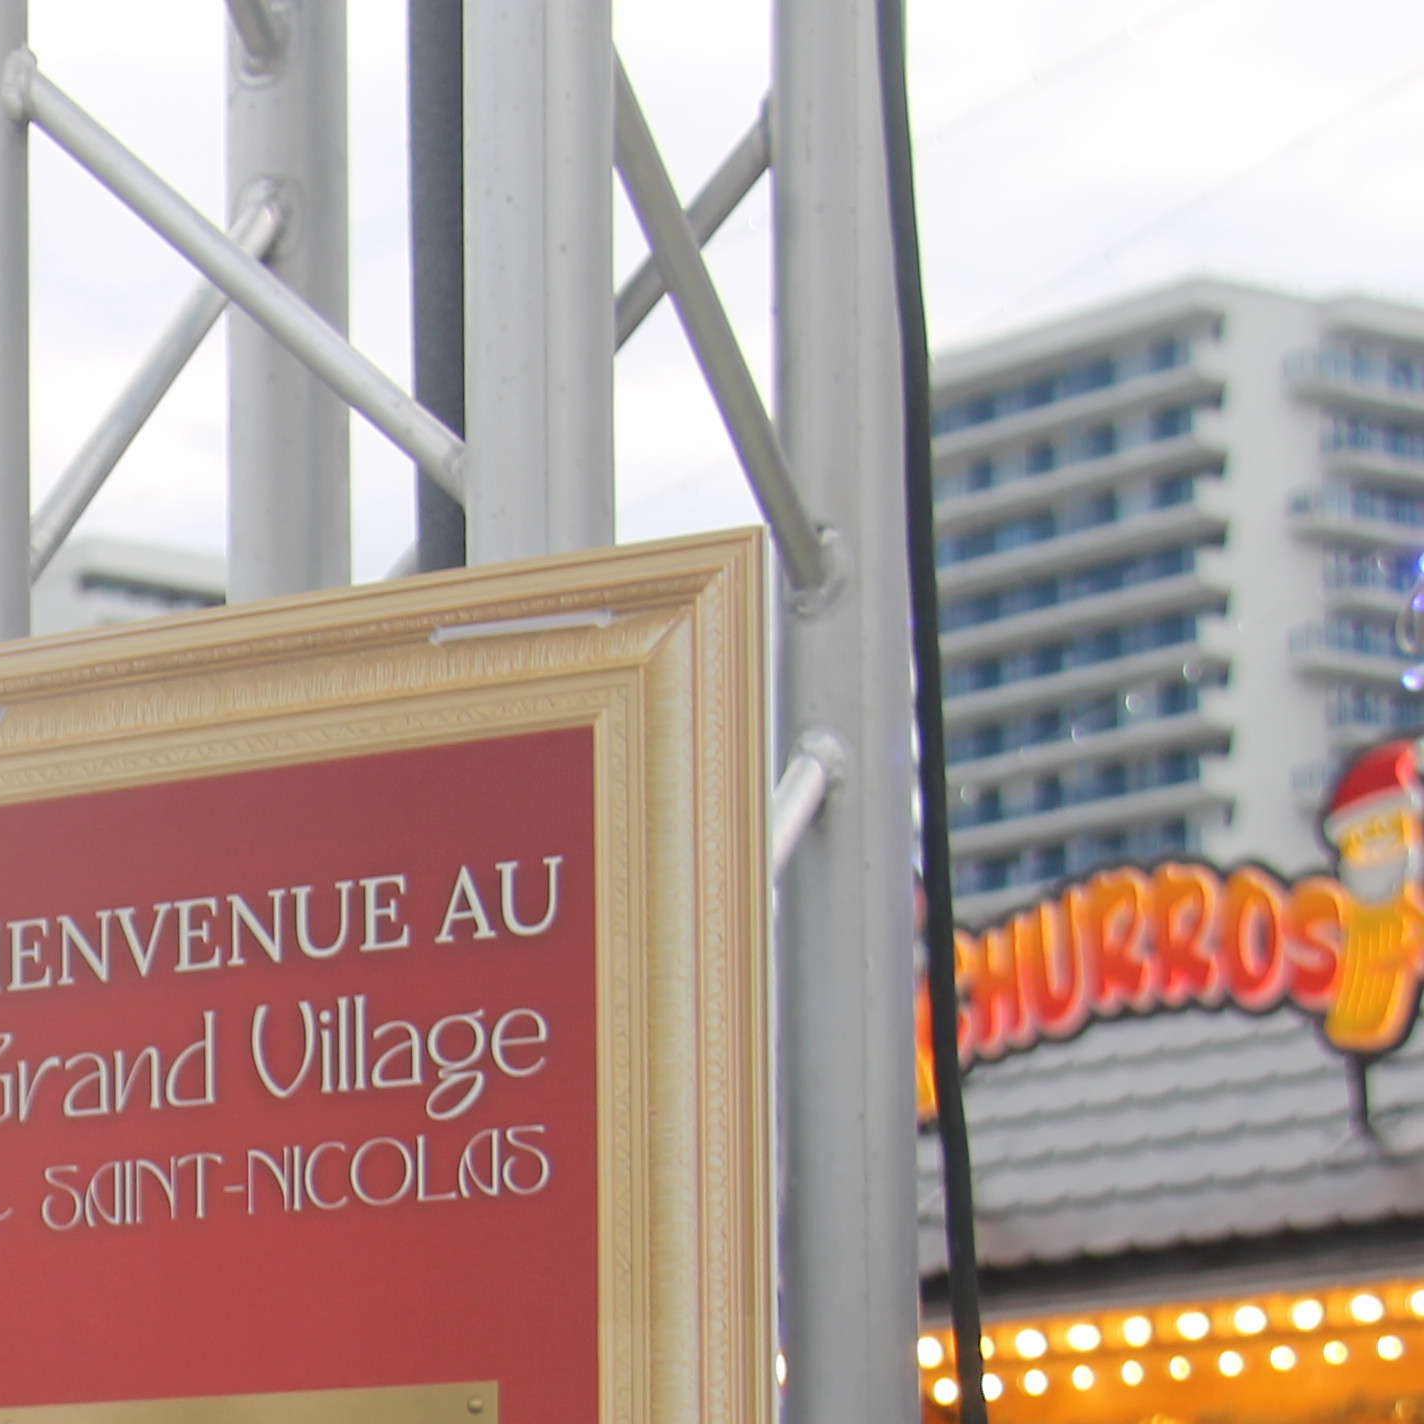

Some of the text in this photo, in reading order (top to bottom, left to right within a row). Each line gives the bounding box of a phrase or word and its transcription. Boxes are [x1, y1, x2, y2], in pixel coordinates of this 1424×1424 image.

[435, 856, 562, 943] AU
[954, 862, 1348, 1064] HURROS
[252, 995, 547, 1120] Village
[42, 1125, 549, 1230] SAINT-NICOLAS
